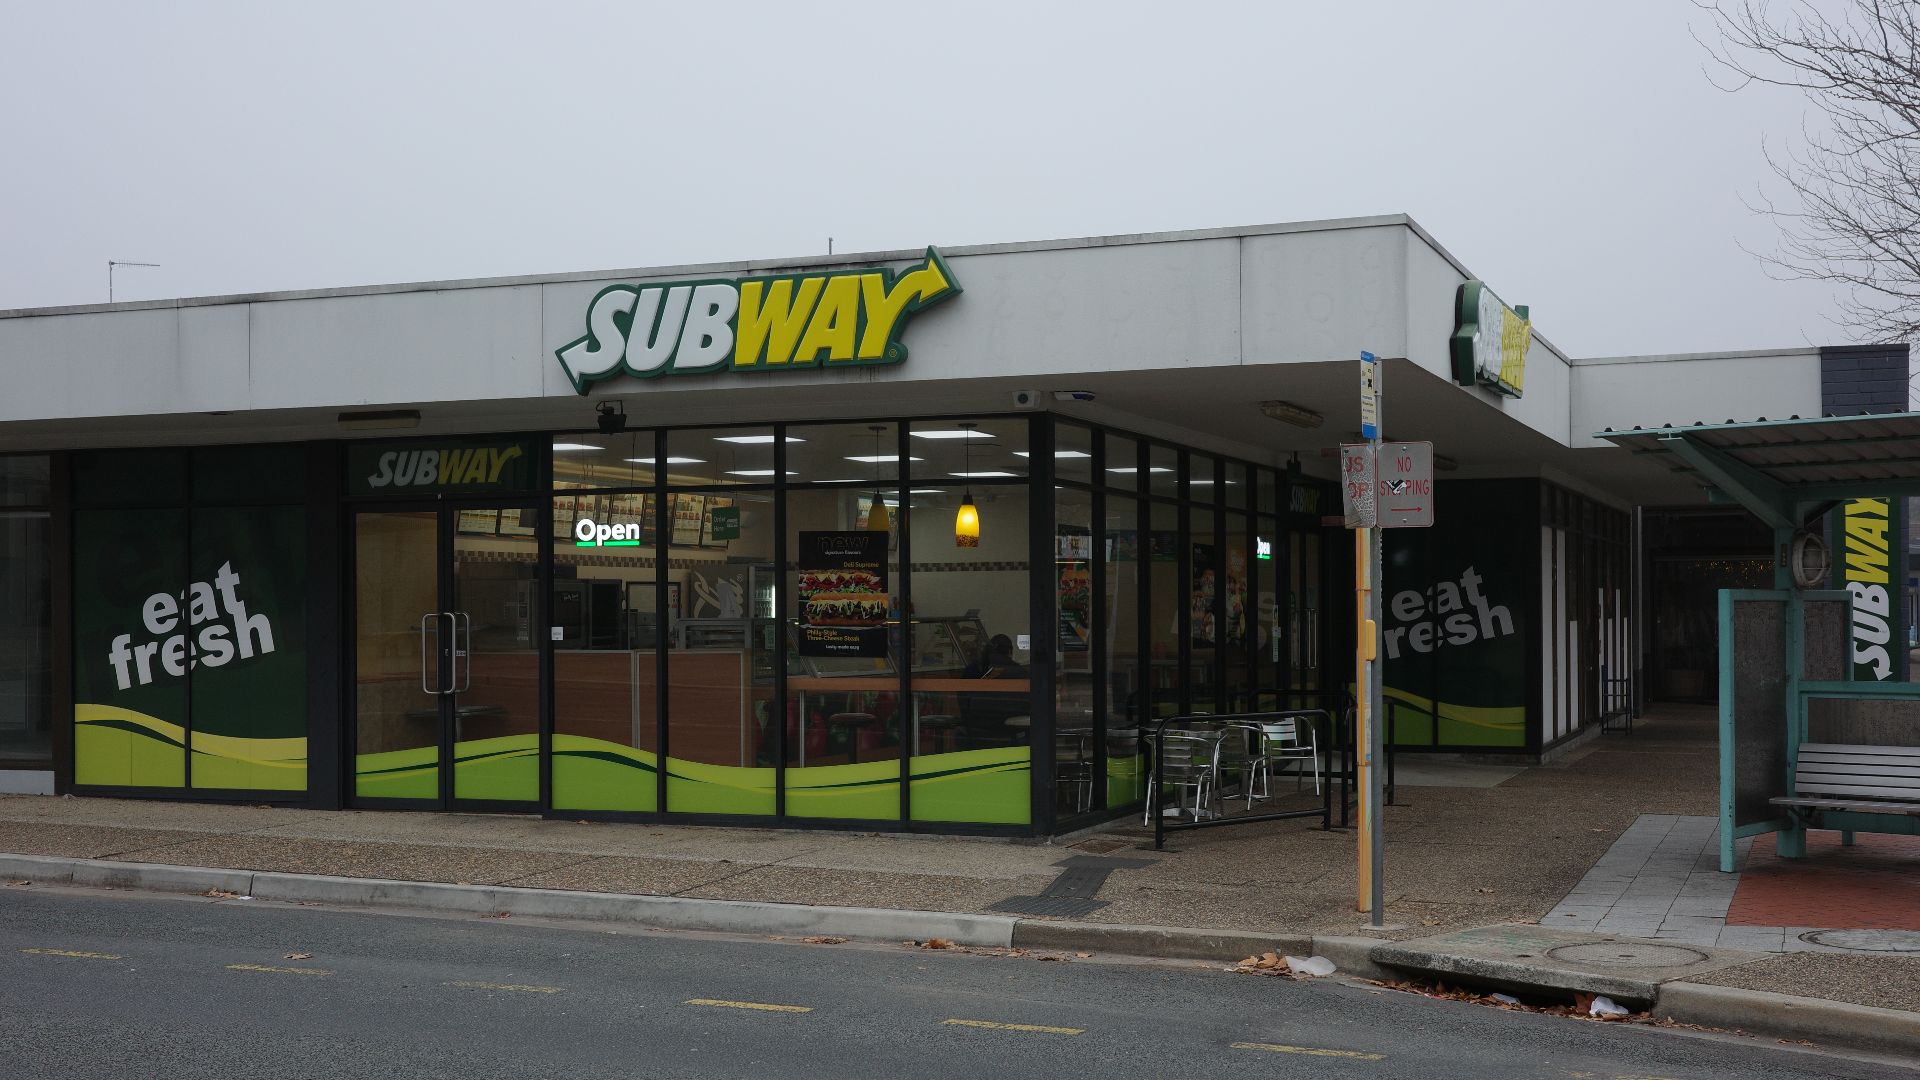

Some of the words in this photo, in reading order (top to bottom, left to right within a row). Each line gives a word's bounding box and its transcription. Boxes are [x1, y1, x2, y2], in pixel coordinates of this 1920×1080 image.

[561, 258, 950, 383] SUBWAY
[369, 444, 523, 488] SUBWAY
[1397, 456, 1412, 473] NO
[576, 518, 641, 547] Open
[818, 536, 870, 552] new
[855, 561, 880, 569] Supreme
[1391, 565, 1488, 622] eat
[1845, 497, 1894, 681] SUBWAY
[142, 560, 244, 634] eat
[109, 601, 276, 691] fresh
[1383, 595, 1515, 660] resh
